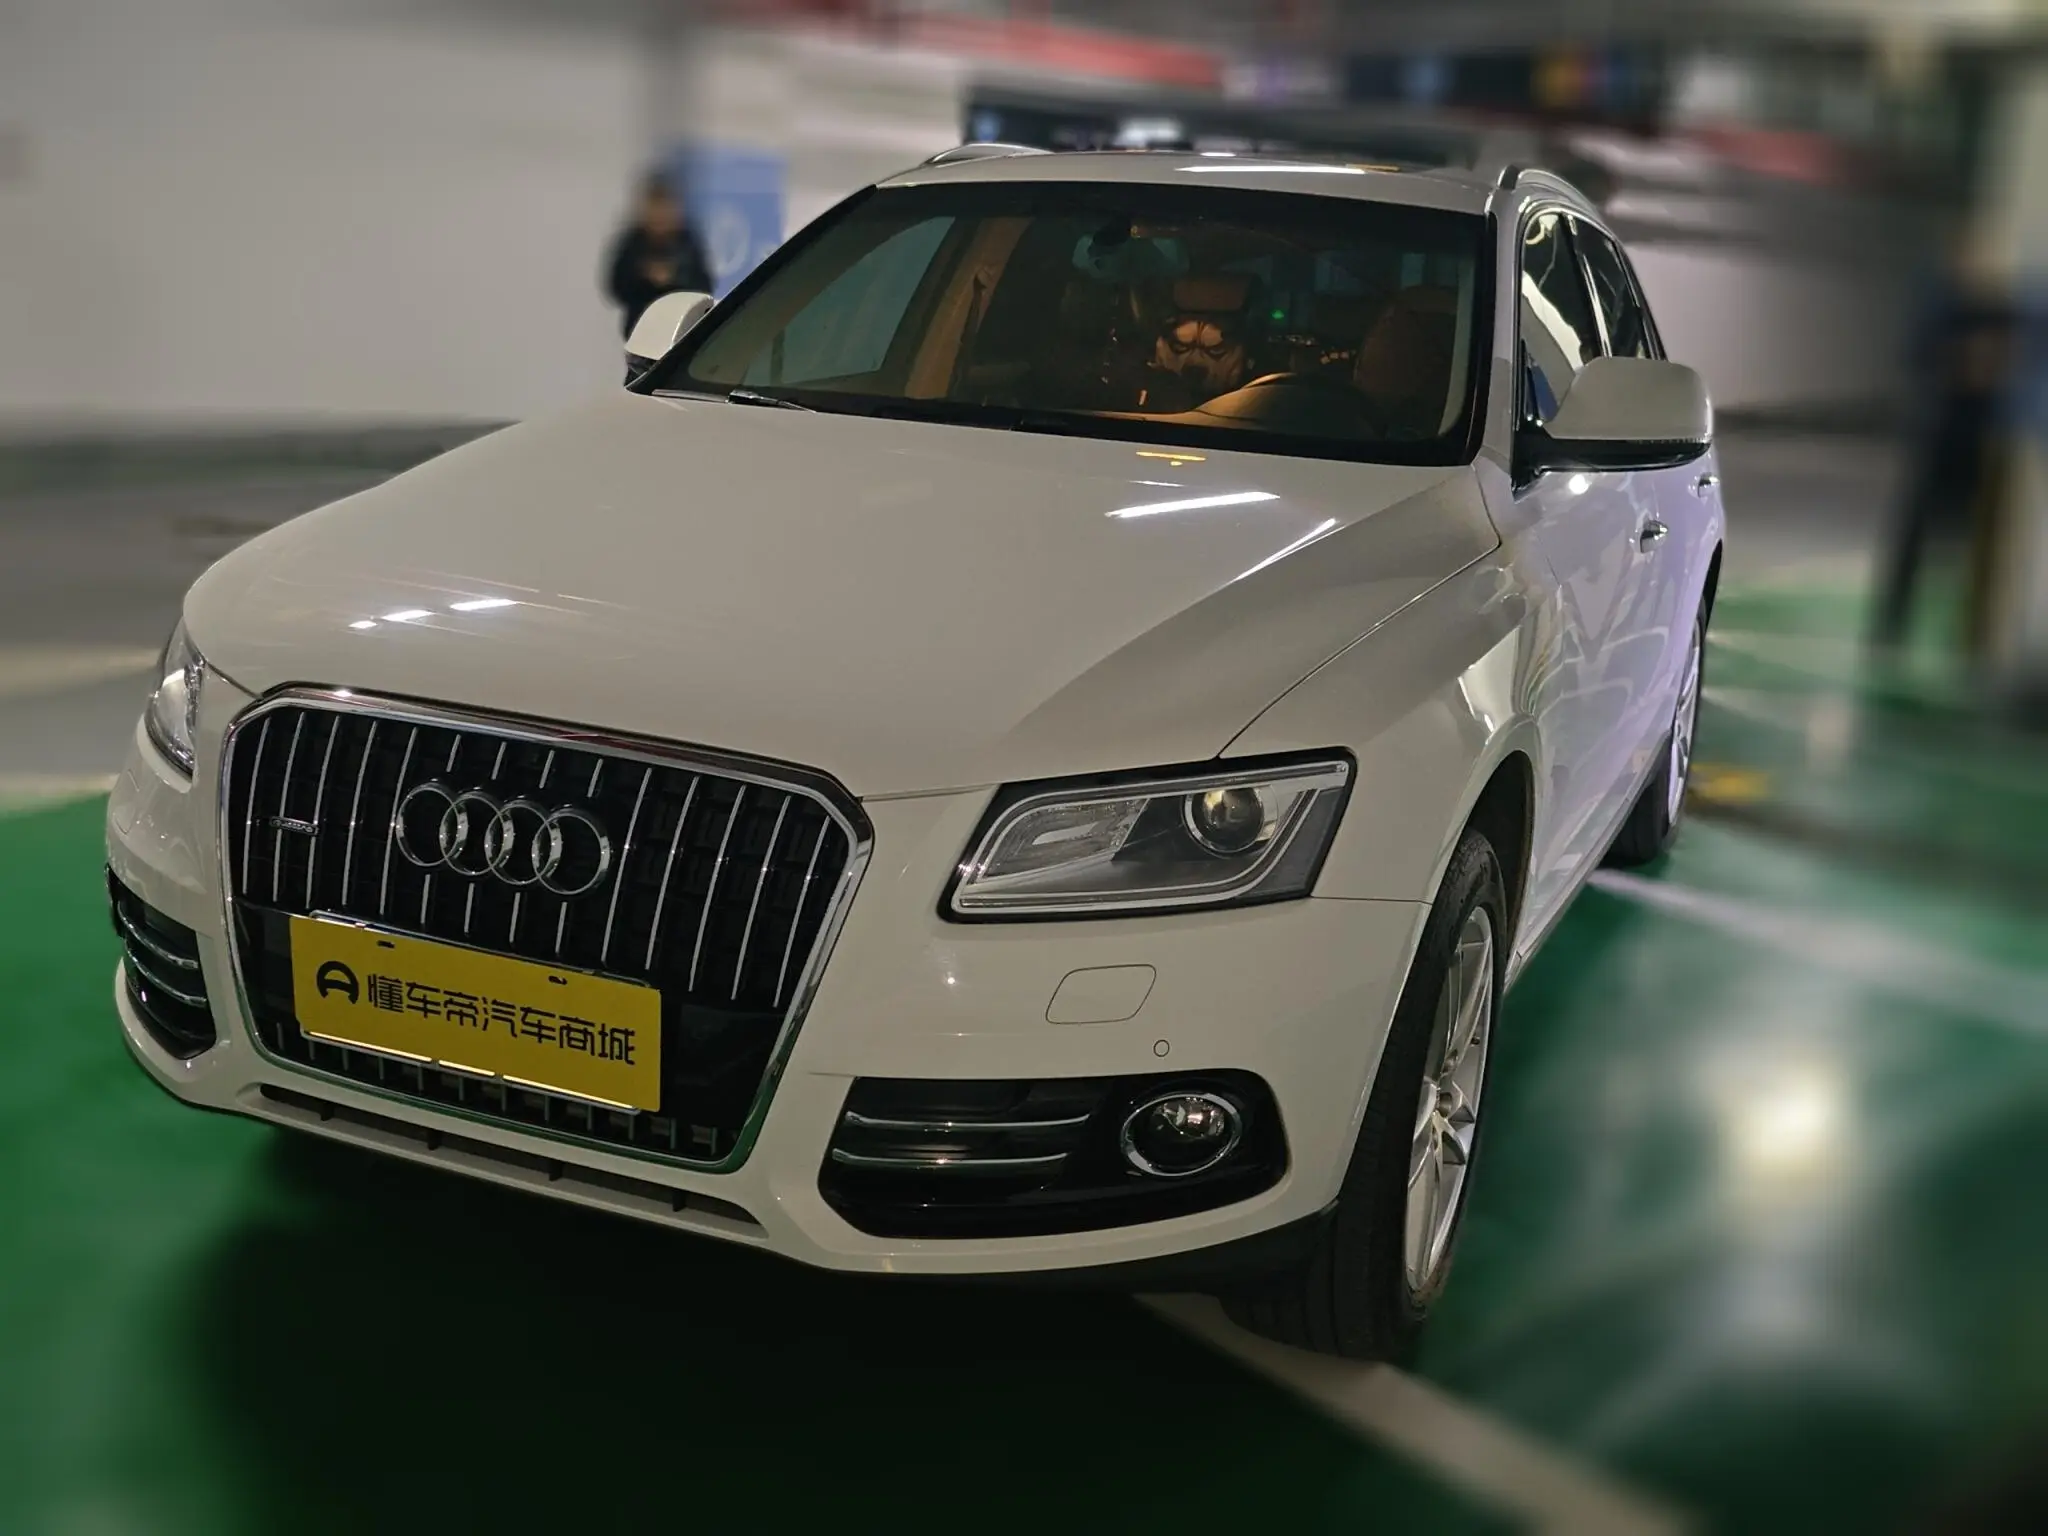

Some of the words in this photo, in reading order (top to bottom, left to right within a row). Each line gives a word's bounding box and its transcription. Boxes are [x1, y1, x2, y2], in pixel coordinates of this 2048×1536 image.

[367, 973, 636, 1066] 懂车帝汽车商城
